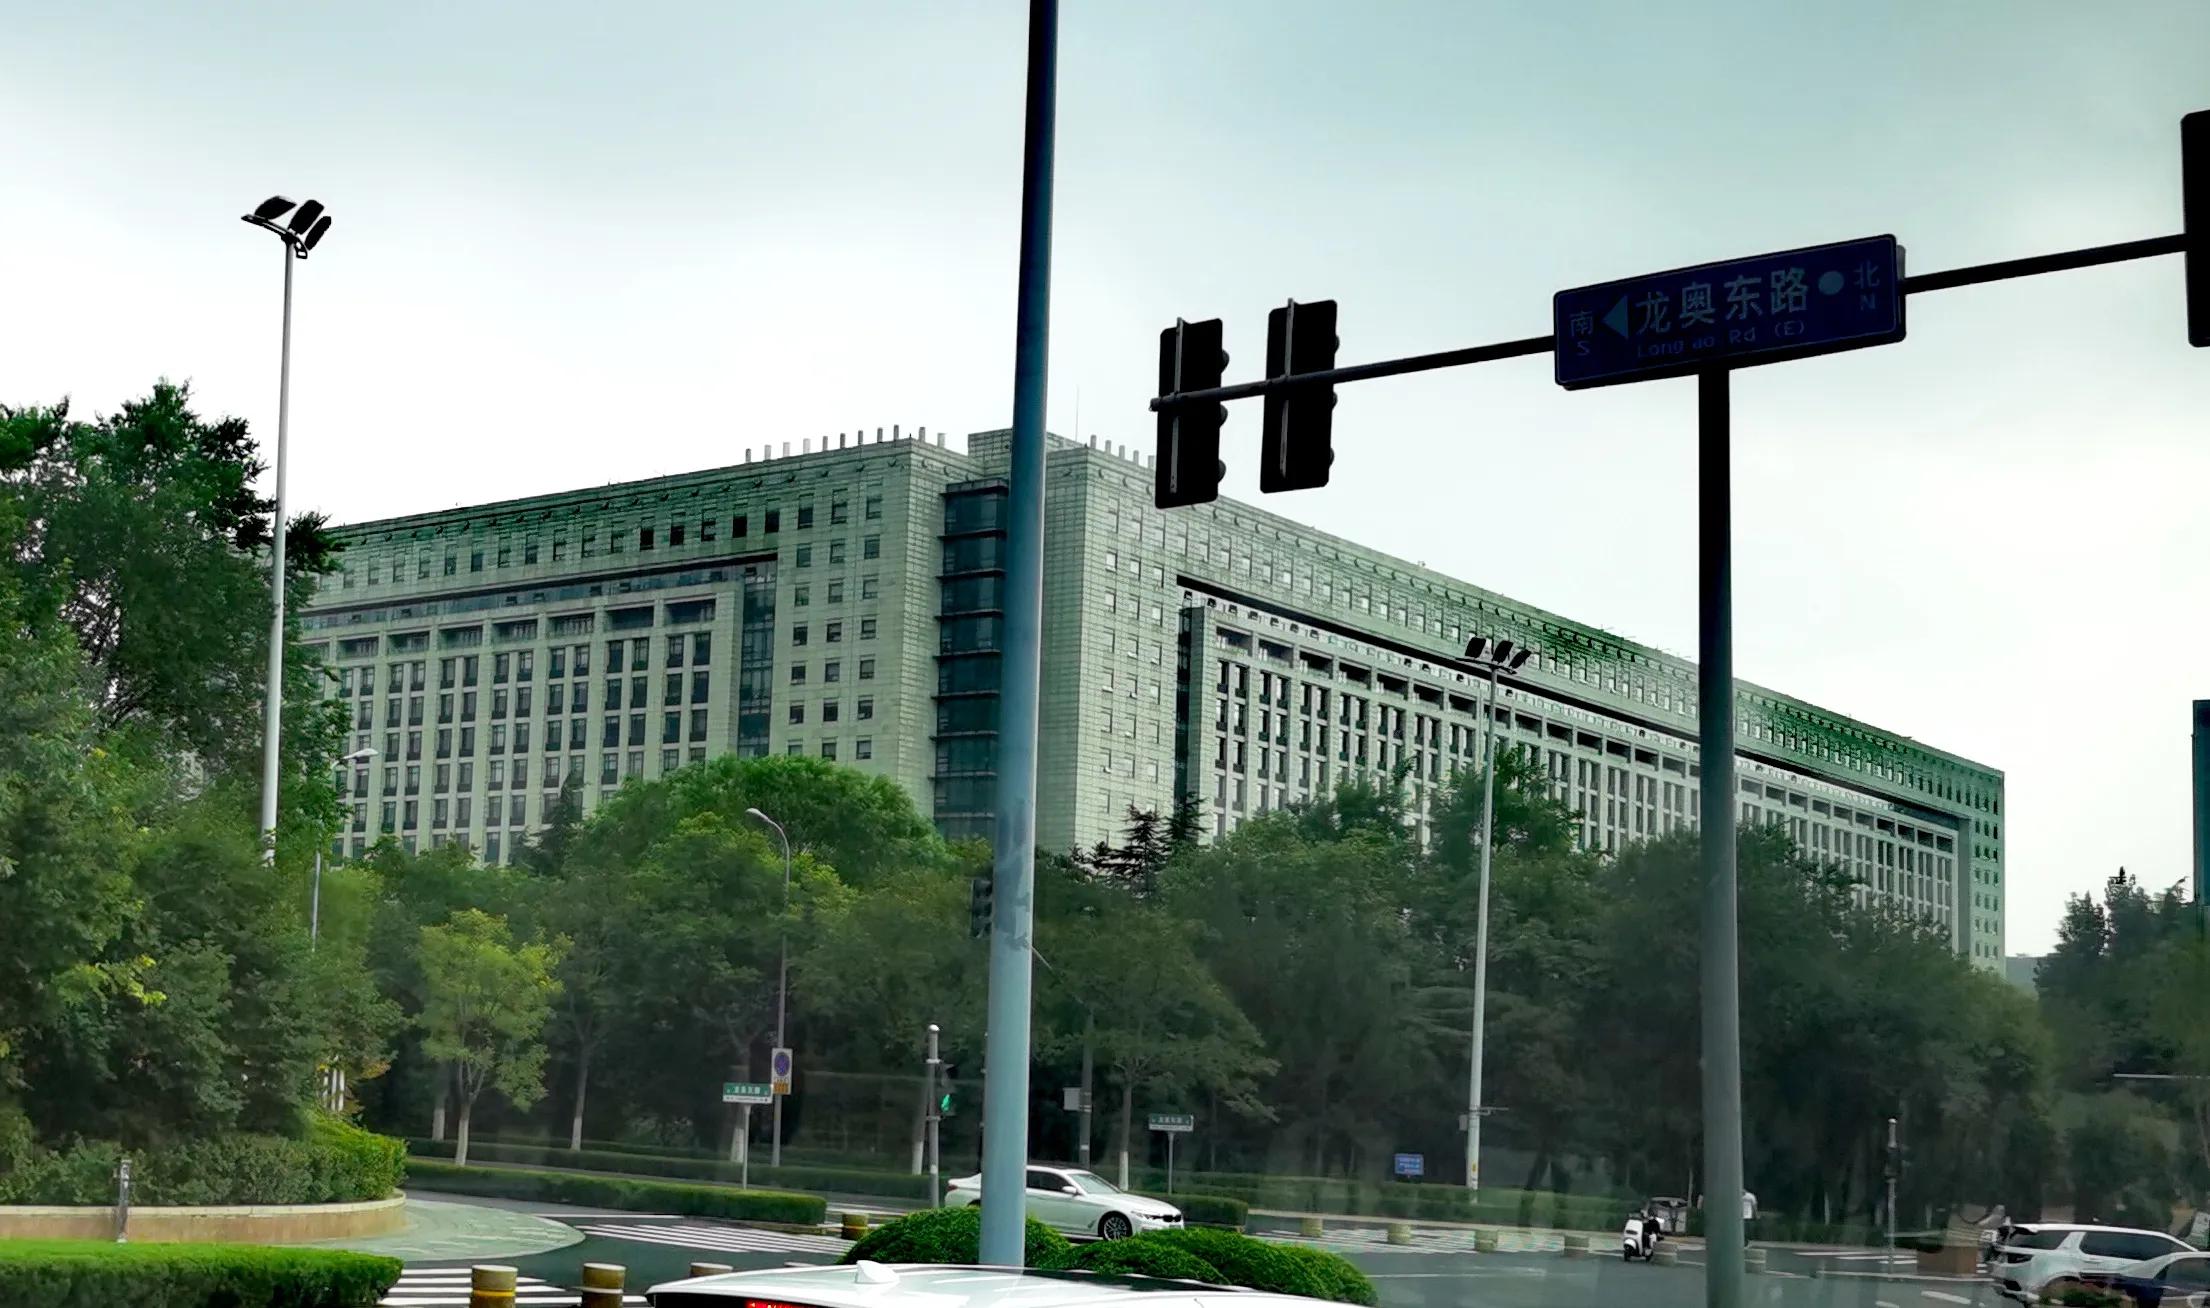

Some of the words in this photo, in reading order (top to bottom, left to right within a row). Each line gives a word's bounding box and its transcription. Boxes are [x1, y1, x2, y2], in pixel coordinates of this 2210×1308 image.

[1854, 260, 1880, 289] 北
[1635, 267, 1809, 336] 龙奥东路
[1860, 294, 1877, 311] N
[1569, 310, 1595, 338] 南
[1576, 341, 1590, 357] S
[1637, 339, 1685, 358] Long
[1729, 327, 1756, 344] Rd
[1773, 320, 1805, 338] (E)
